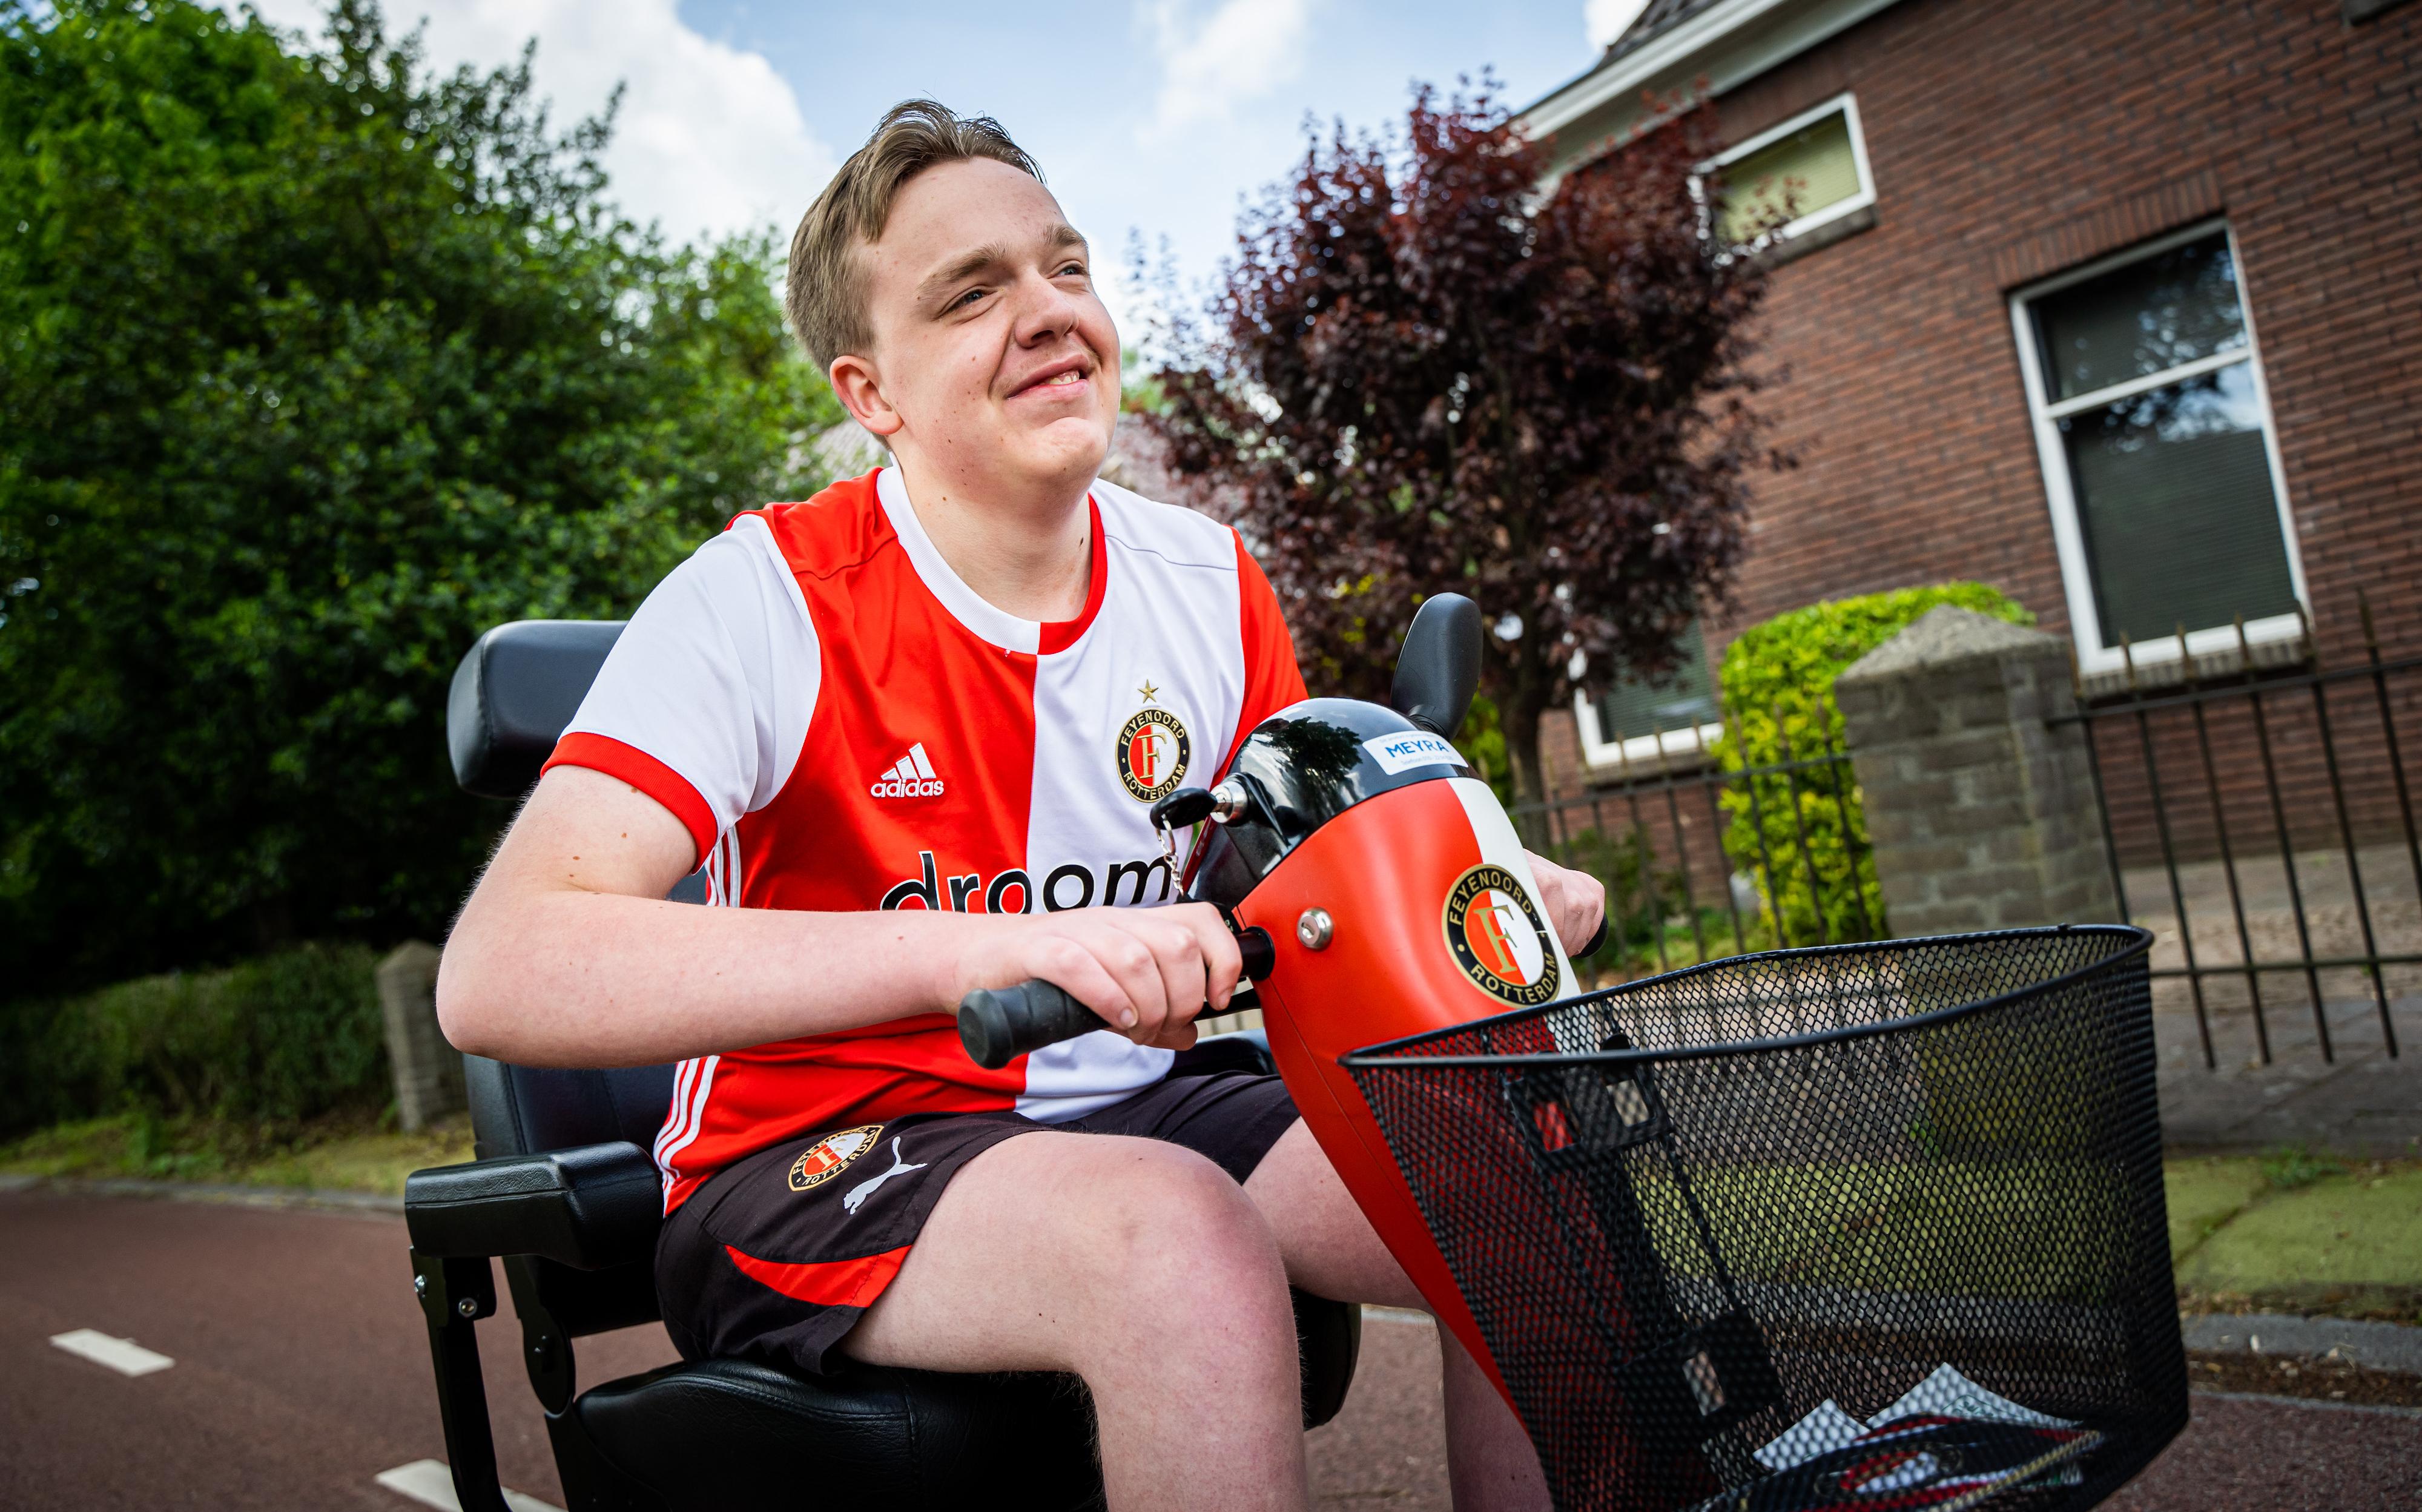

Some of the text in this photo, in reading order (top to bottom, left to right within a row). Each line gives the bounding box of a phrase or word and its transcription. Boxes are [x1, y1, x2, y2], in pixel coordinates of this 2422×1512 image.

[1121, 710, 1185, 746] FEYENOORD
[1385, 740, 1450, 758] MEYRA
[1137, 733, 1167, 779] F
[870, 778, 945, 798] adidas
[1123, 764, 1186, 800] ROTTERDAM
[880, 851, 1173, 915] droom
[1449, 871, 1533, 926] FEYENOORD
[1473, 905, 1517, 974] F
[1471, 952, 1557, 1003] ROTTERDAM
